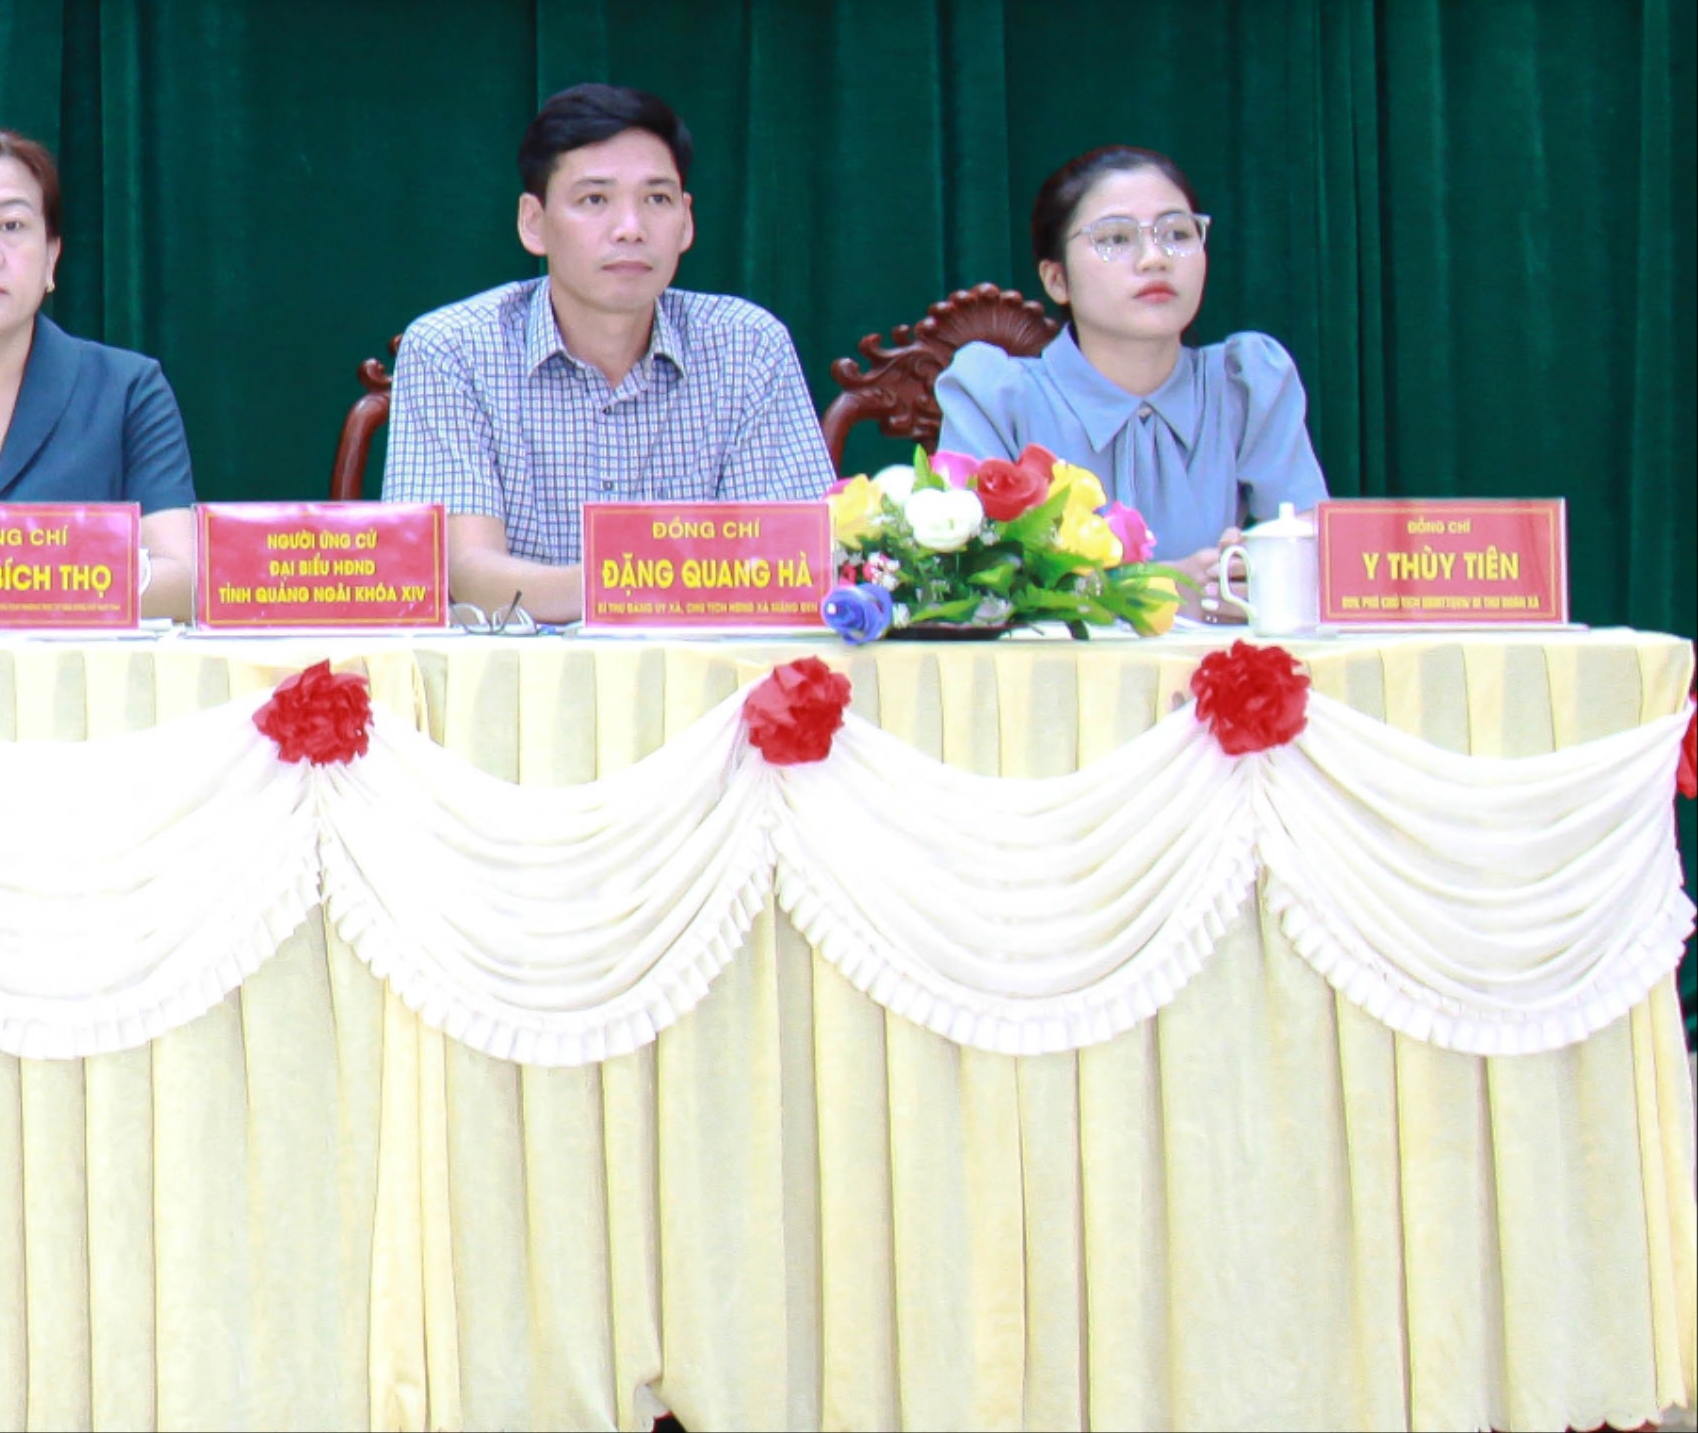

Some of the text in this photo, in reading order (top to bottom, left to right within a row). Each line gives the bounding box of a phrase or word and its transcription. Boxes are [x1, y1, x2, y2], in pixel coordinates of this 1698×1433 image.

[30, 526, 68, 545] CHÍ
[267, 528, 377, 549] NGƯỜI ỨNG CỬ
[653, 517, 760, 539] ĐỒNG CHÍ
[1448, 519, 1470, 533] CHÍ
[270, 553, 375, 580] ĐẠI BIỂU HĐND
[603, 552, 813, 596] ĐẶNG QUANG HÀ
[1363, 553, 1379, 580] Y
[1464, 545, 1518, 580] TIÊN
[60, 565, 111, 597] THỌ
[219, 577, 426, 603] TỈNH QUẢNG NGÃI KHÓA XIV
